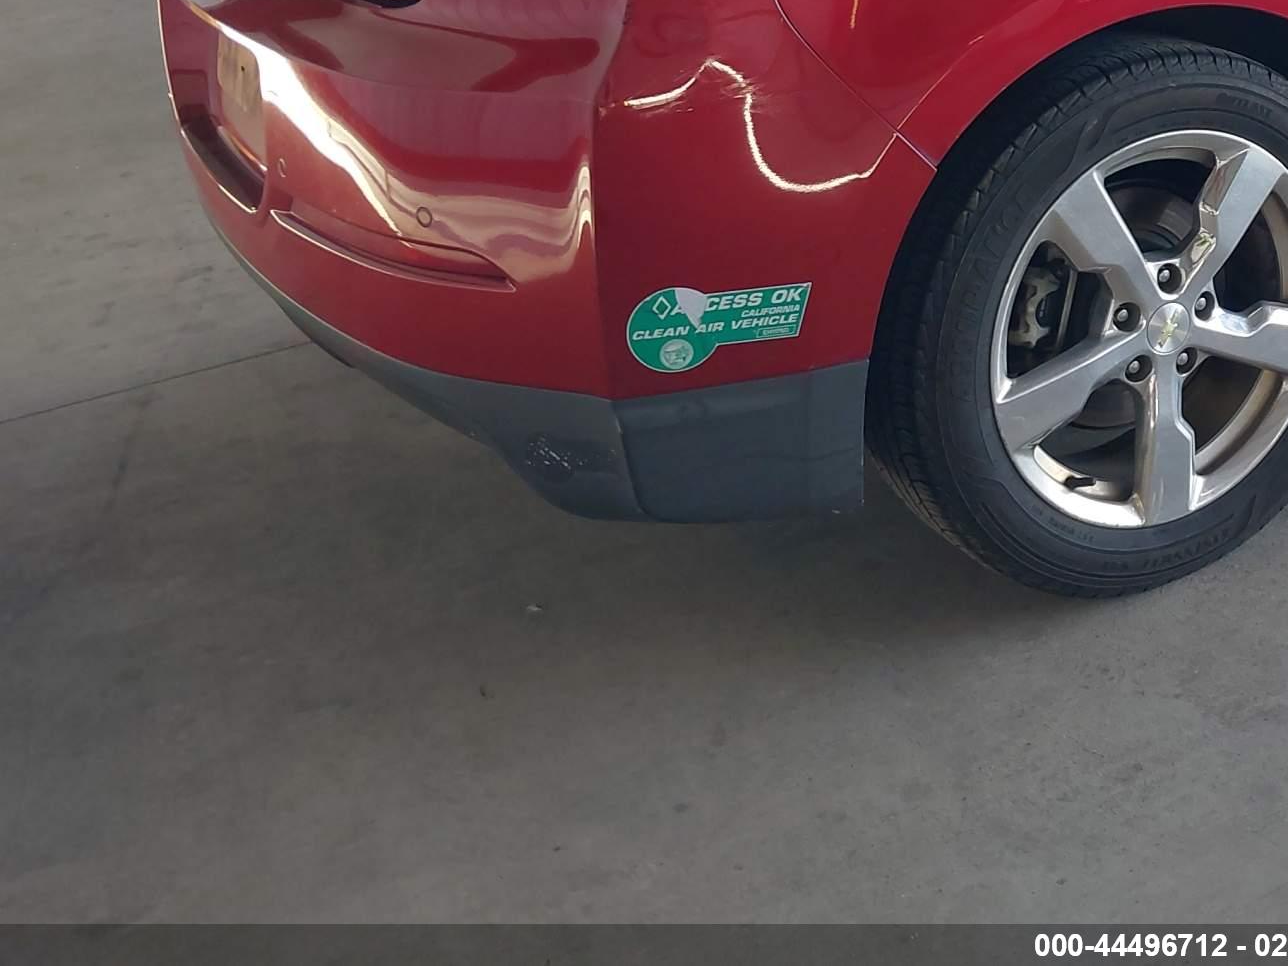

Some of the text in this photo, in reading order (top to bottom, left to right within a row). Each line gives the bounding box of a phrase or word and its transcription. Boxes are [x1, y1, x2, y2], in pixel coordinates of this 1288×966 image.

[771, 288, 805, 304] OK
[741, 304, 800, 317] CALIFORNIA
[632, 313, 800, 340] CLEAN AIR VEHICLE
